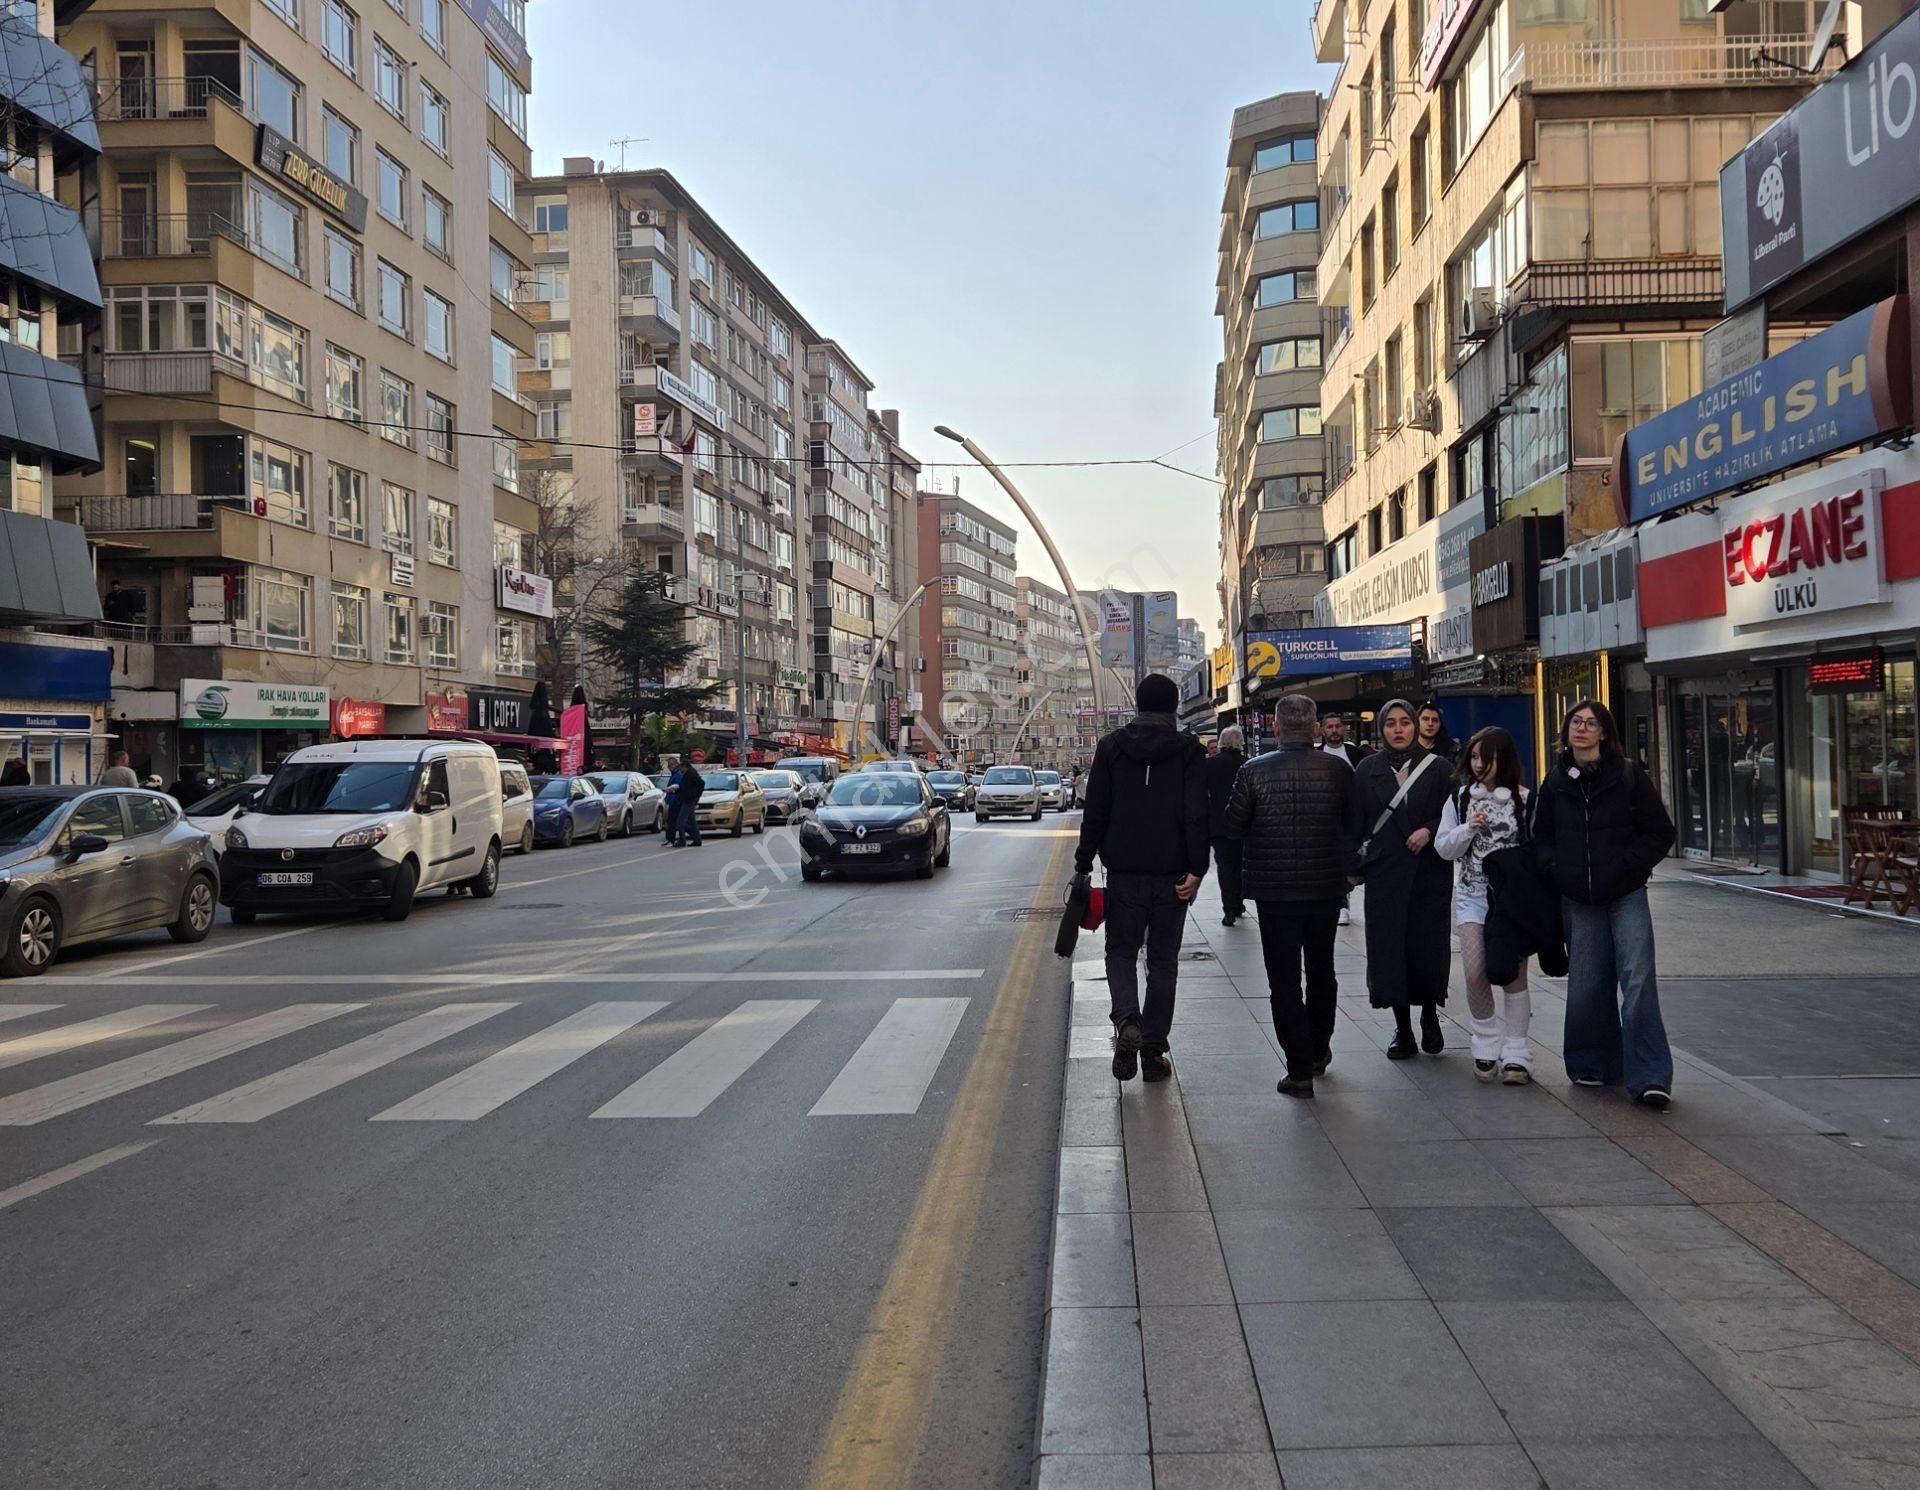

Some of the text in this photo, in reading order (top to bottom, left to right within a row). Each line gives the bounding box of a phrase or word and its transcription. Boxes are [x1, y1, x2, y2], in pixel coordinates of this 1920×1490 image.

[1754, 222, 1797, 261] Liberal Parti
[1697, 370, 1763, 421] ACADEMIC
[1638, 354, 1866, 486] ENGLISH
[1715, 446, 1773, 480] HAZIRLIK
[1780, 420, 1839, 455] ATLAMA
[1724, 488, 1868, 587] ECZANE
[1372, 560, 1399, 616] GELİŞİM
[1401, 549, 1430, 602] KURSU
[1775, 577, 1817, 613] ÜLKÜ
[1277, 640, 1338, 652] TURKCELL
[257, 688, 326, 703] IRAK HAVA YOLLARI
[493, 698, 521, 728] COFFY
[890, 698, 898, 740] MIGROS
[262, 874, 273, 883] 06
[297, 874, 312, 883] 259
